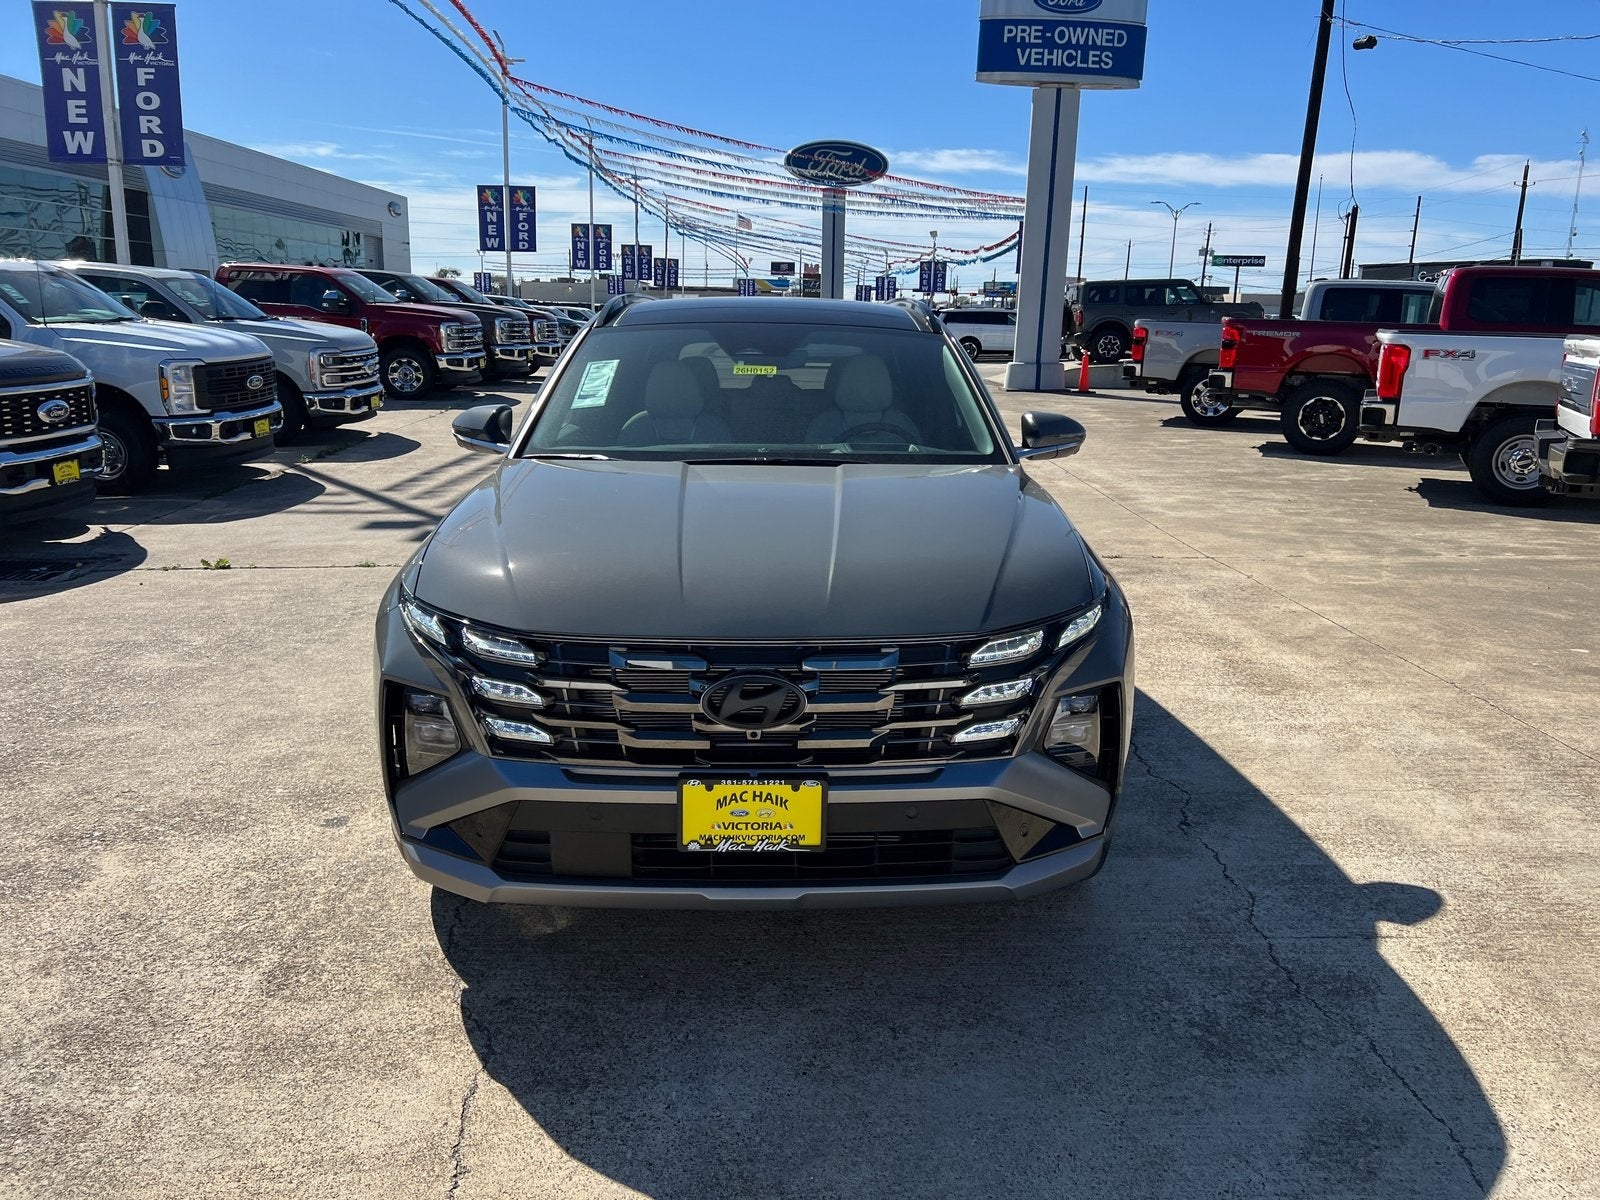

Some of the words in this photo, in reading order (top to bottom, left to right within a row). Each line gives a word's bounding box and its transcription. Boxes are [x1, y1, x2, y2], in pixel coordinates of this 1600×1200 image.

[1016, 48, 1113, 69] VEHICLES
[61, 67, 95, 155] NEW
[135, 67, 165, 158] FORD
[808, 148, 868, 178] Ford
[485, 211, 500, 248] NEW
[517, 212, 529, 250] FORD
[576, 241, 586, 268] NEW
[598, 242, 607, 269] FORD
[1216, 256, 1265, 266] enterprise
[641, 259, 649, 280] FORD
[1251, 329, 1301, 338] TREMOR
[1422, 349, 1476, 361] FX4
[715, 791, 749, 811] MAC
[752, 791, 790, 811] HAIK
[721, 821, 784, 831] VICTORIA
[715, 839, 750, 853] Mac
[752, 838, 794, 853] Haik
